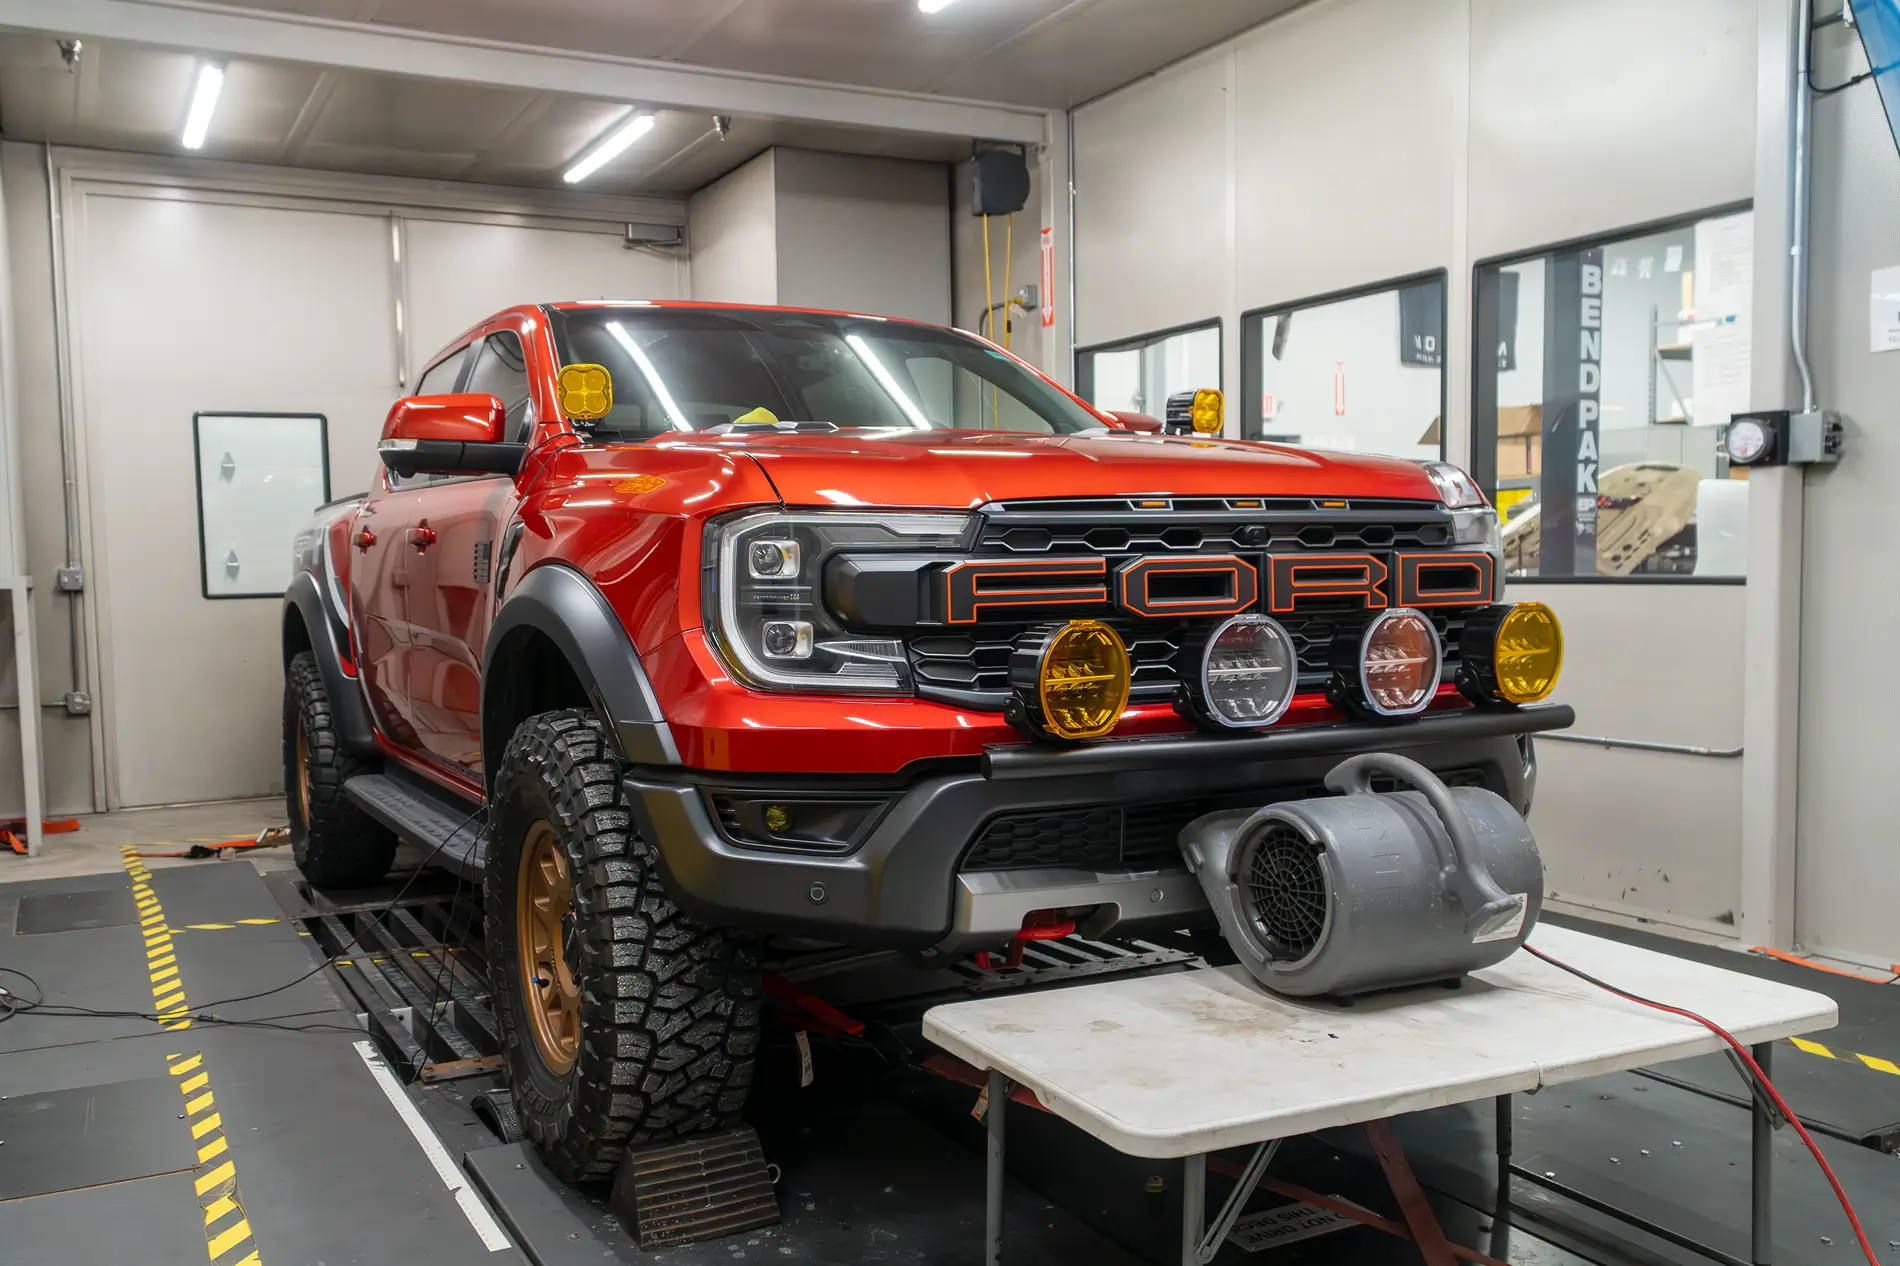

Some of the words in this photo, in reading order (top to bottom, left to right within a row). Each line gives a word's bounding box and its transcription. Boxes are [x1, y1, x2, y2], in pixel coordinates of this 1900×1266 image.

[1577, 264, 1602, 493] BENDPAK
[946, 552, 1495, 625] FORD
[1277, 1207, 1317, 1222] THIS
[1302, 1214, 1332, 1230] NOT
[1242, 1225, 1298, 1244] DRIVE
